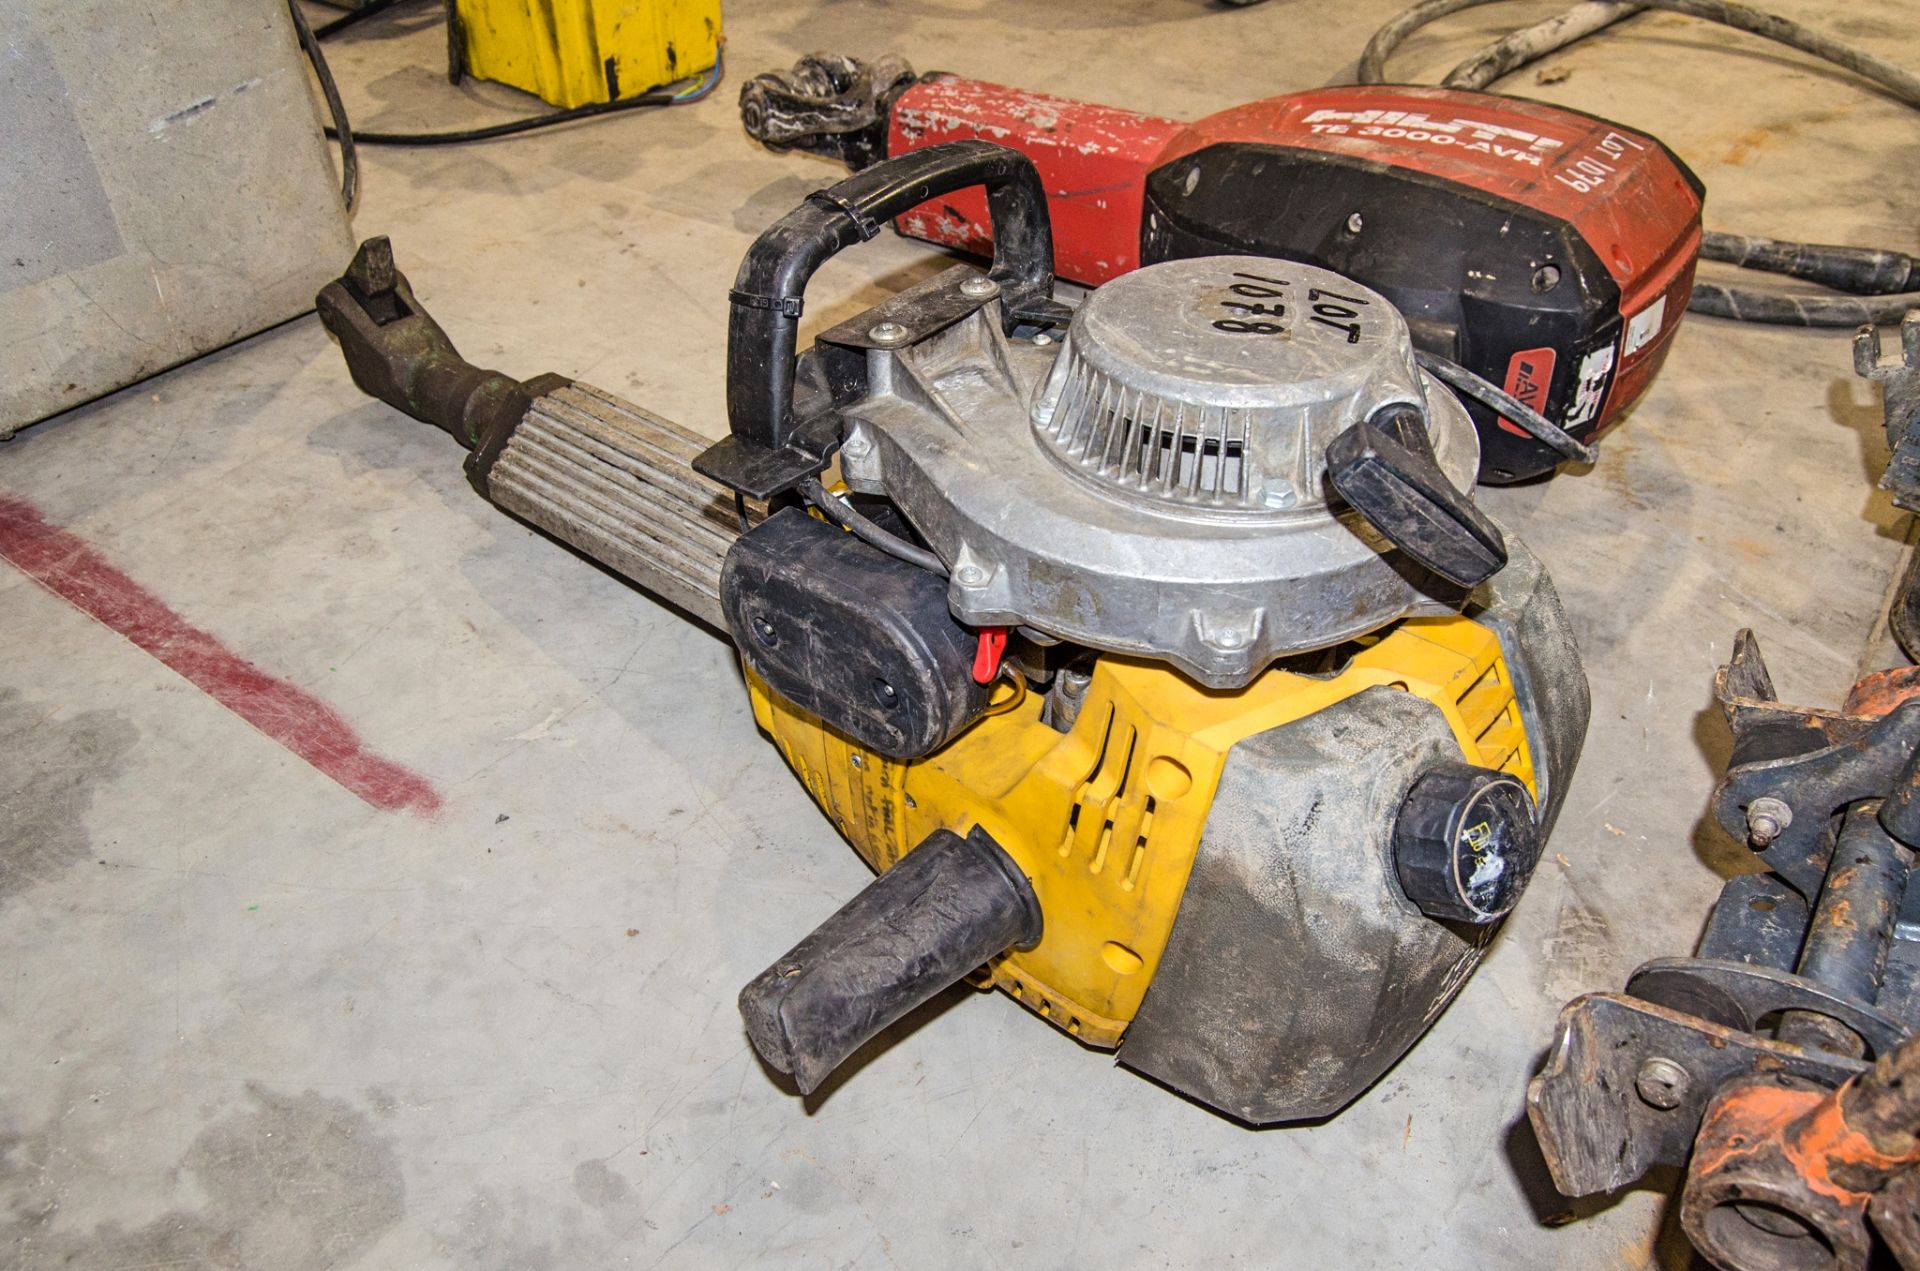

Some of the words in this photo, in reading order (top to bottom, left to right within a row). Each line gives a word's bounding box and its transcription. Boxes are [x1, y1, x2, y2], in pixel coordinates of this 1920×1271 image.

[1302, 109, 1564, 150] HILTI
[1310, 123, 1350, 134] TE
[1358, 125, 1543, 166] 3000-AVR
[1595, 132, 1644, 160] LOT
[1554, 155, 1616, 193] 1079
[1212, 272, 1291, 335] 1078
[1308, 287, 1370, 344] LOT
